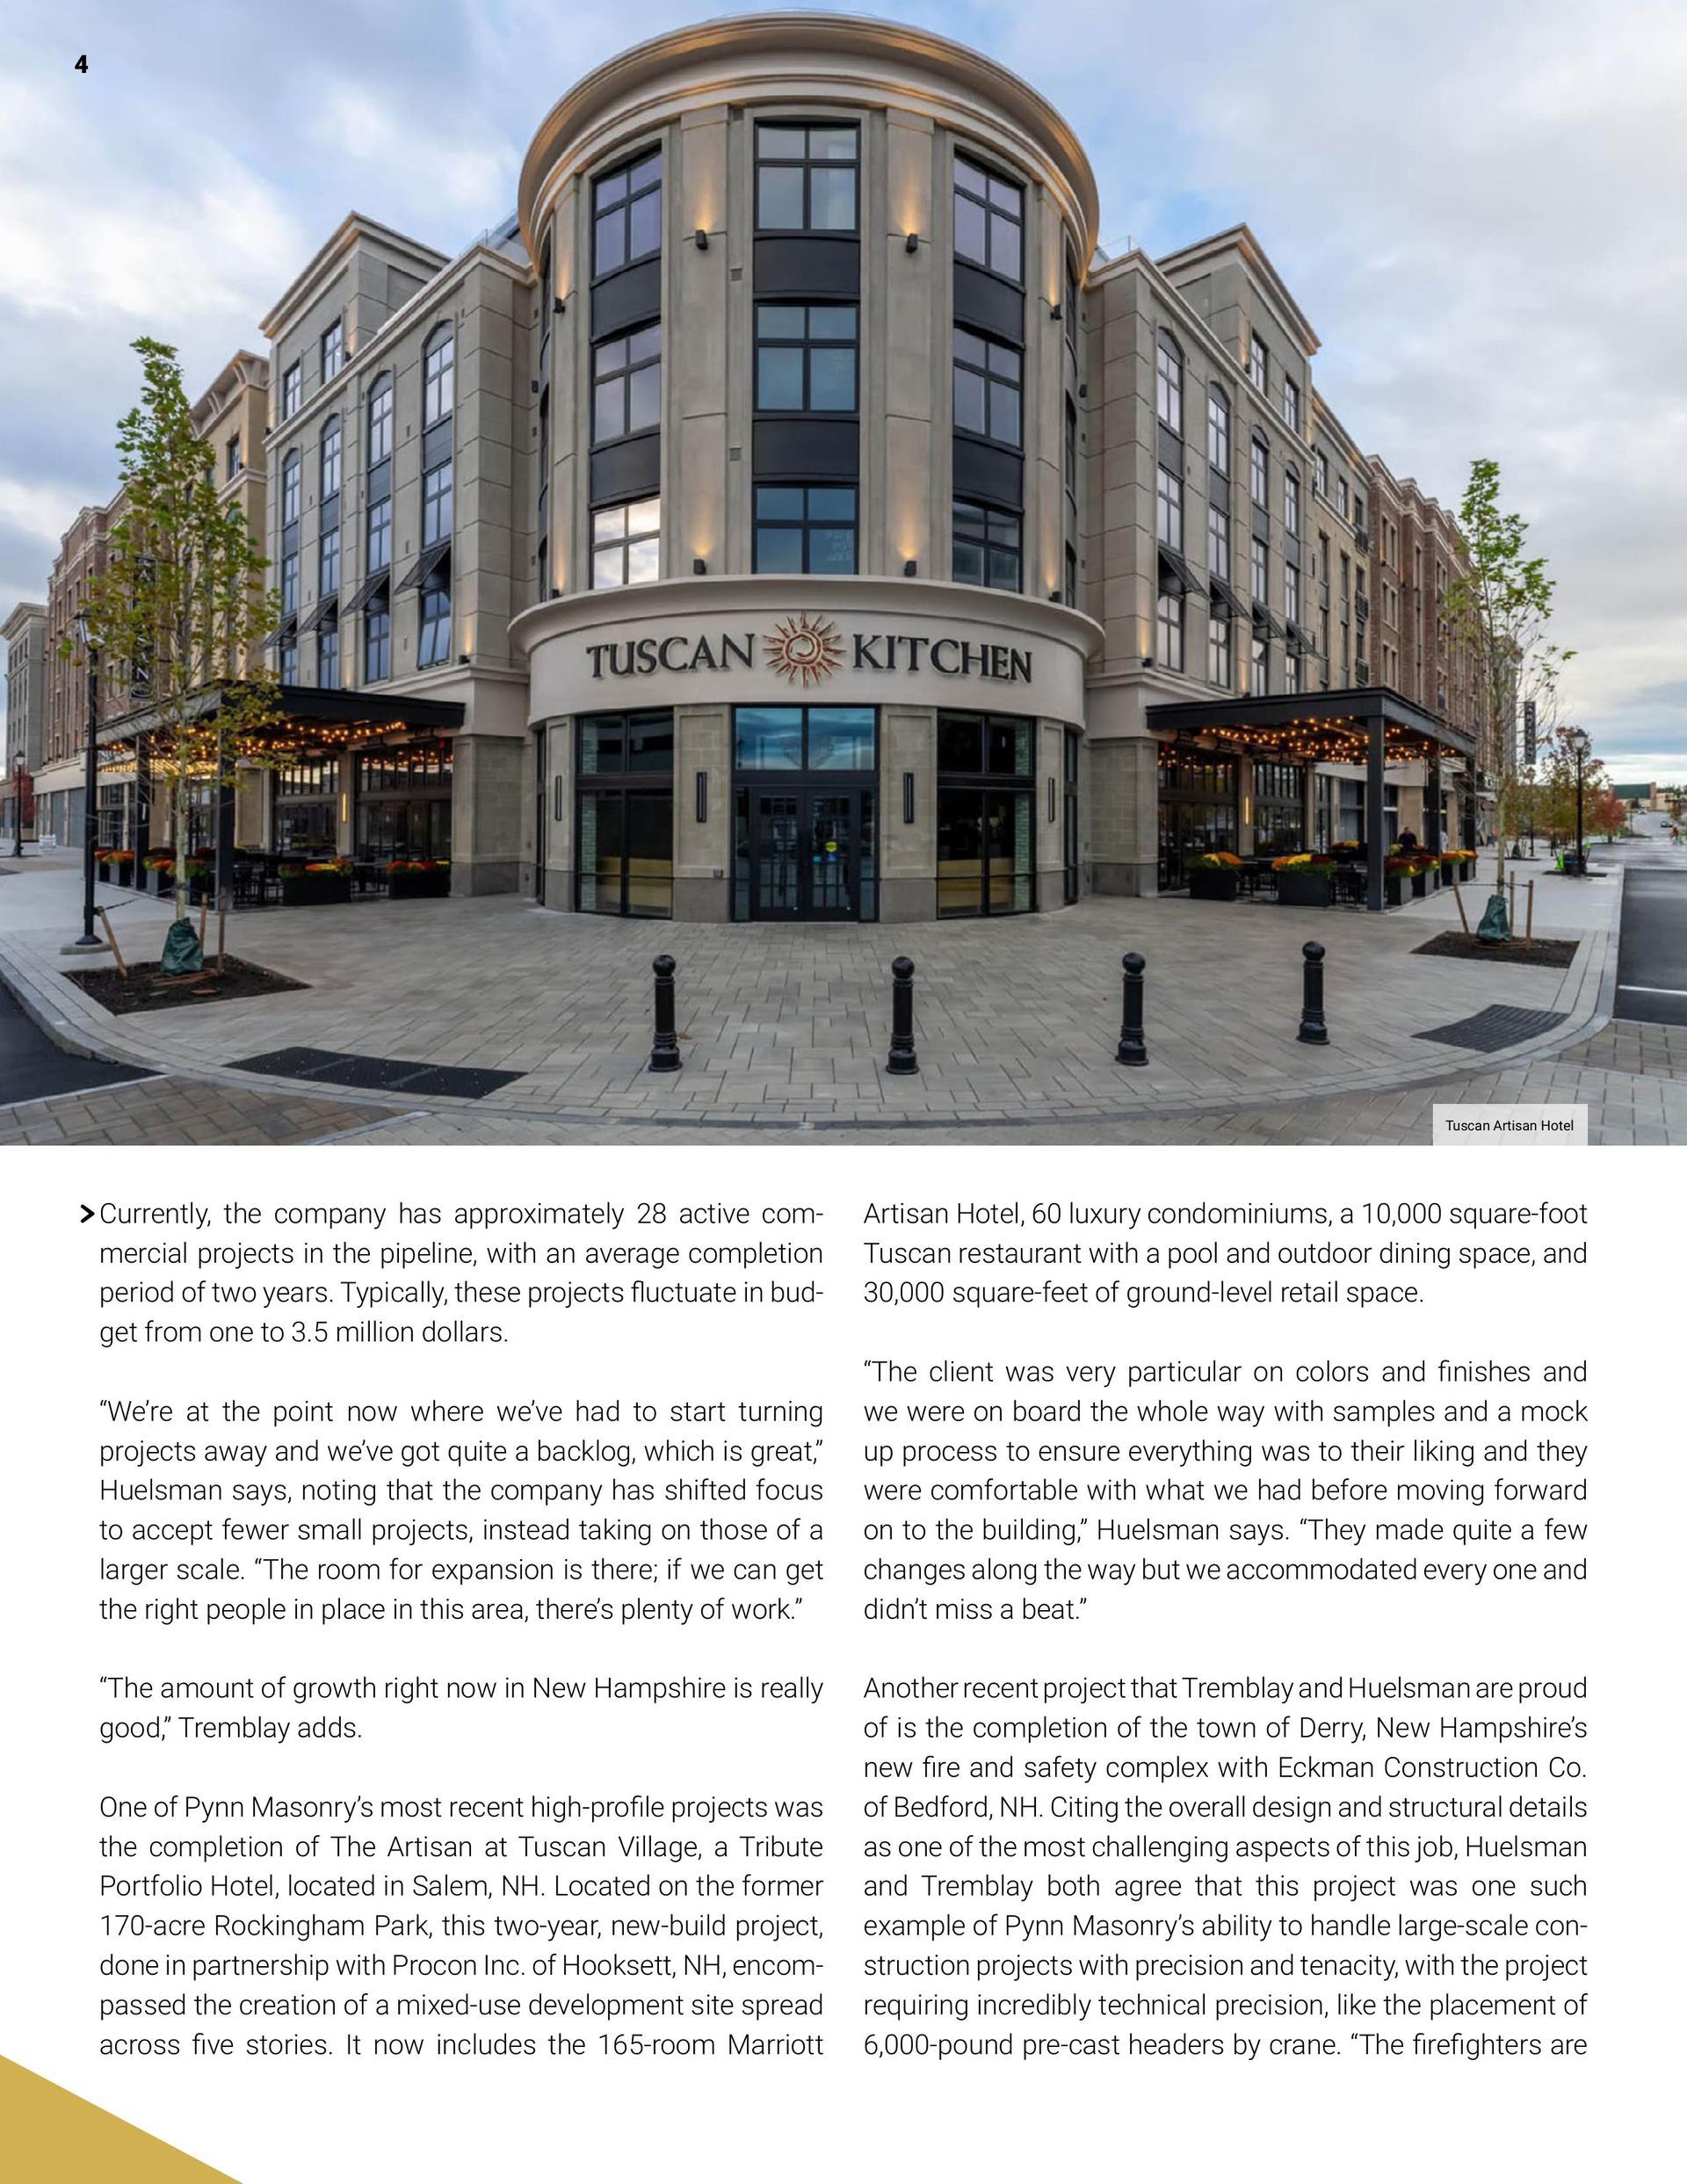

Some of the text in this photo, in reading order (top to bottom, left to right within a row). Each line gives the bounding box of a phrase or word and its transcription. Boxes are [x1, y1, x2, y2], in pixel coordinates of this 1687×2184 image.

[586, 633, 1032, 684] TUSCAN KITCHEN
[101, 1202, 823, 1230] Currently, the company has approximately 28 active com-
[864, 1201, 1587, 1229] Artisan Hotel, 60 luxury condominiums, a 10,000 square-foot
[865, 1281, 1423, 1308] 30,000 square-feet of ground-level retail space.
[100, 1320, 507, 1347] get from one to 3.5 million dollars.
[865, 1400, 1588, 1427] we were on board the whole way with samples and a mock
[101, 1440, 822, 1467] projects away and we’ve got quite a backlog, which is great,”
[865, 1478, 1586, 1506] were comfortable with what we had before moving forward
[101, 1557, 823, 1585] larger scale. “The room for expansion is there; if we can get
[865, 1598, 1086, 1619] didn’t miss a beat.”
[100, 1716, 361, 1744] good,” Tremblay adds.
[865, 1756, 1586, 1783] new fire and safety complex with Eckman Construction Co.
[99, 1835, 822, 1862] the completion of The Artisan at Tuscan Village, a Tribute
[865, 1835, 1586, 1862] as one of the most challenging aspects of this job, Huelsman
[102, 1914, 822, 1941] 170-acre Rockingham Park, this two-year, new-build project,
[865, 1954, 1587, 1981] struction projects with precision and tenacity, with the project
[101, 1993, 822, 2021] passed the creation of a mixed-use development site spread
[865, 2033, 1587, 2060] 6,000-pound pre-cast headers by crane. “The firefighters are
